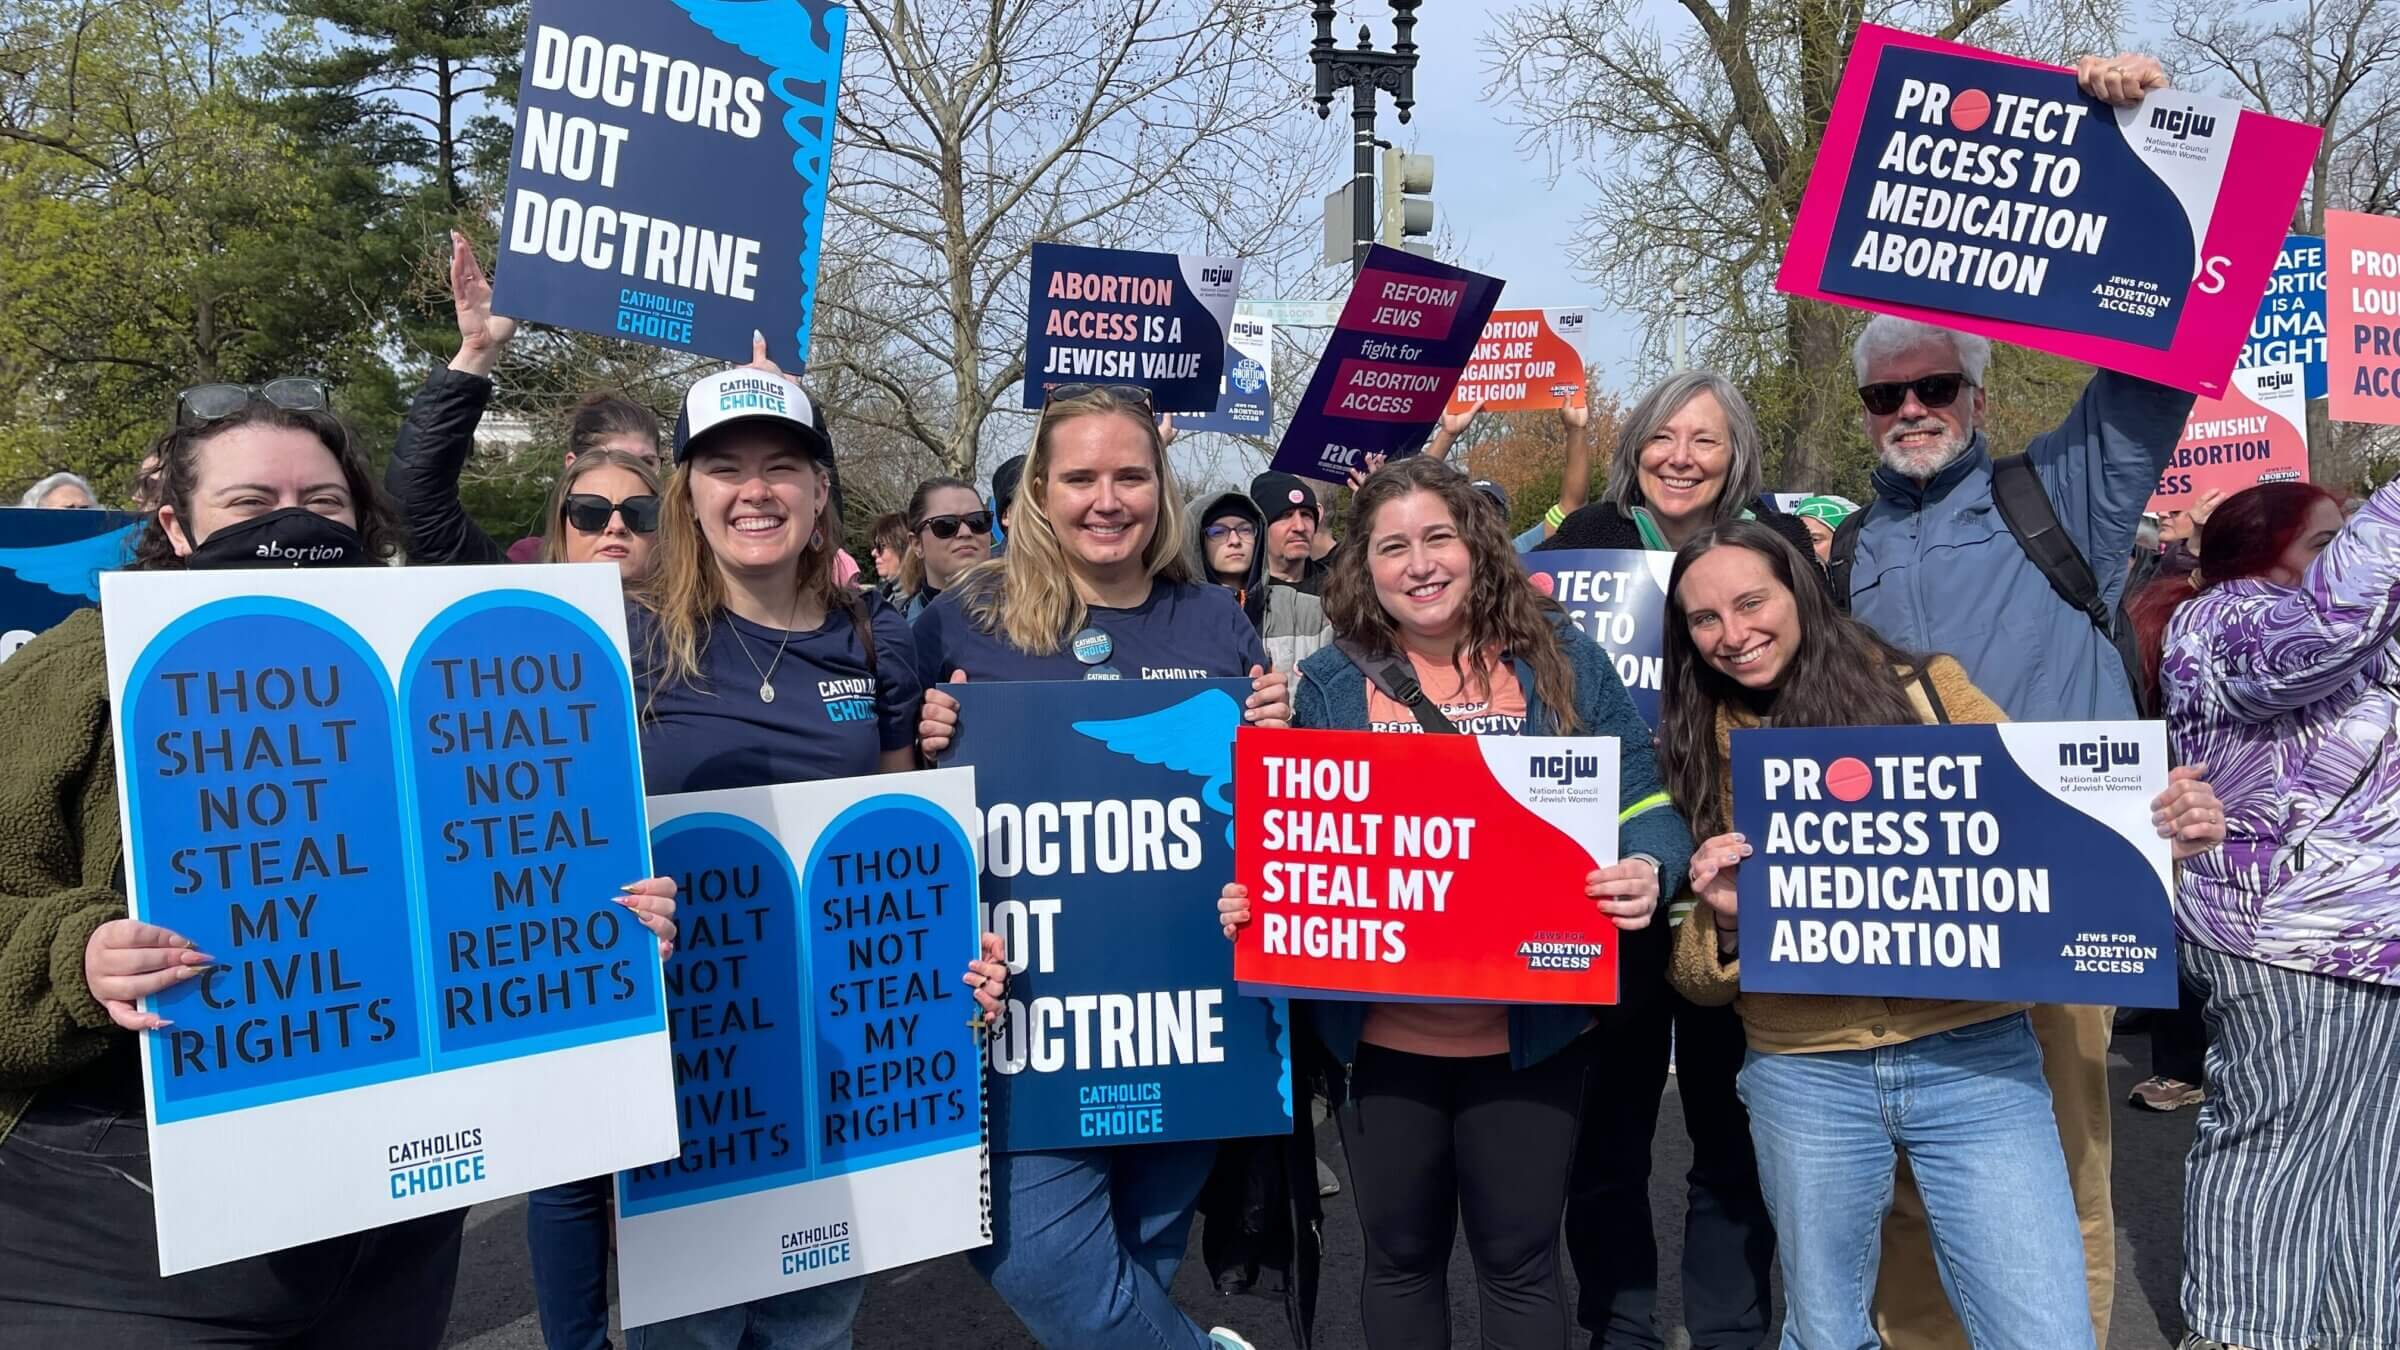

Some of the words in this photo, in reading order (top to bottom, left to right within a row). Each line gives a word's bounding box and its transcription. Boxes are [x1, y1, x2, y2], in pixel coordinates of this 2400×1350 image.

[531, 24, 765, 139] DOCTORS
[2150, 105, 2216, 140] ncjw
[520, 105, 629, 188] NOT
[2145, 136, 2178, 148] National
[2179, 142, 2209, 154] Council
[2151, 146, 2177, 157] Jewish
[2179, 150, 2207, 161] Women
[1878, 130, 2024, 189] ACCESS
[2029, 152, 2081, 198] TO
[1866, 180, 2108, 255] MEDICATION
[509, 188, 761, 302] DOCTRINE
[2272, 247, 2321, 271] AFE
[1201, 265, 1233, 287] ncjw
[1851, 230, 2049, 296] ABORTION
[2351, 248, 2400, 279] PRO
[1047, 271, 1173, 306] ABORTION
[1381, 281, 1458, 307] REFORM
[2091, 283, 2171, 308] ABORTION
[2108, 275, 2136, 287] JEWS
[2137, 280, 2158, 292] FOR
[620, 288, 694, 317] CATHOLICS
[1371, 306, 1422, 328] JEWS
[2098, 297, 2156, 318] ACCESS
[2272, 298, 2288, 312] IS
[2291, 296, 2306, 311] A
[2352, 287, 2400, 316] LOU
[616, 310, 692, 344] CHOICE
[1045, 309, 1138, 342] ACCESS
[1143, 315, 1165, 343] IS
[1167, 317, 1182, 344] A
[1233, 321, 1264, 337] ncjw
[1481, 320, 1539, 340] ORTION
[1559, 312, 1583, 327] ncjw
[2249, 311, 2327, 339] UMA
[1043, 346, 1136, 378] JEWISH
[1141, 352, 1201, 379] VALUE
[1238, 359, 1259, 369] KEEP
[1360, 339, 1397, 360] fight
[1399, 343, 1423, 361] for
[1469, 342, 1501, 361] ANS
[1503, 341, 1534, 359] ARE
[720, 379, 784, 396] CATHOLICS
[1232, 367, 1265, 380] ABORTION
[1235, 378, 1262, 390] LEGAL
[1349, 369, 1440, 392] ABORTION
[1459, 362, 1523, 381] AGAINST
[1524, 361, 1556, 379] OUR
[2257, 370, 2293, 390] ncjw
[720, 394, 787, 414] CHOICE
[1340, 392, 1414, 413] ACCESS
[1457, 382, 1527, 402] RELIGION
[2184, 415, 2268, 442] JEWISHLY
[2168, 439, 2271, 469] ABORTION
[2259, 471, 2301, 481] ABORTION
[255, 540, 343, 560] abortion
[1594, 610, 1635, 645] TO
[1077, 643, 1111, 657] CHOICE
[161, 665, 340, 716] THOU
[431, 653, 582, 699] THOU
[428, 703, 596, 754] SHALT
[156, 719, 357, 776] SHALT
[2058, 735, 2140, 773] ncjw
[466, 757, 573, 806] NOT
[1262, 756, 1370, 802] THOU
[1530, 749, 1598, 785] ncjw
[2060, 775, 2101, 783] National
[2103, 775, 2142, 783] Council
[1529, 787, 1565, 795] National
[1566, 787, 1598, 795] Council
[2060, 784, 2070, 792] of
[2072, 784, 2104, 792] Jewish
[2105, 783, 2142, 791] Women
[199, 778, 328, 832] NOT
[442, 808, 608, 862] STEAL
[1262, 808, 1383, 855] SHALT
[1393, 815, 1476, 860] NOT
[1765, 811, 1930, 856] ACCESS
[1939, 811, 2000, 856] TO
[171, 833, 369, 894] STEAL
[827, 843, 940, 887] THOU
[493, 863, 567, 912] MY
[676, 864, 760, 906] HOU
[1262, 860, 1377, 908] STEAL
[1388, 868, 1454, 912] MY
[1768, 865, 2050, 913] MEDICATION
[230, 894, 318, 947] MY
[823, 884, 950, 931] SHALT
[448, 911, 620, 973] REPRO
[848, 929, 929, 971] NOT
[1263, 912, 1407, 963] RIGHTS
[1519, 941, 1602, 955] ABORTION
[1535, 931, 1561, 939] JEWS
[1565, 932, 1585, 940] FOR
[1770, 919, 2001, 969] ABORTION
[2060, 944, 2158, 960] ABORTION
[2076, 933, 2108, 942] JEWS
[2111, 934, 2137, 943] FOR
[201, 948, 362, 1009] CIVIL
[664, 955, 747, 997] NOT
[1530, 956, 1590, 969] ACCESS
[2074, 959, 2145, 974] ACCESS
[445, 959, 635, 1029] RIGHTS
[829, 969, 952, 1017] STEAL
[668, 997, 775, 1042] TEAL
[864, 1014, 920, 1054] MY
[991, 988, 1225, 1075] OCTRINE
[171, 998, 396, 1077] RIGHTS
[676, 1044, 737, 1086] MY
[829, 1050, 956, 1103] REPRO
[684, 1086, 767, 1129] IVIL
[1080, 1082, 1161, 1104] CATHOLICS
[825, 1088, 965, 1146] RIGHTS
[1080, 1108, 1163, 1137] CHOICE
[388, 1128, 482, 1164] CATHOLICS
[390, 1155, 486, 1199] CHOICE
[781, 1221, 849, 1249] CATHOLICS
[782, 1242, 850, 1275] CHOICE
